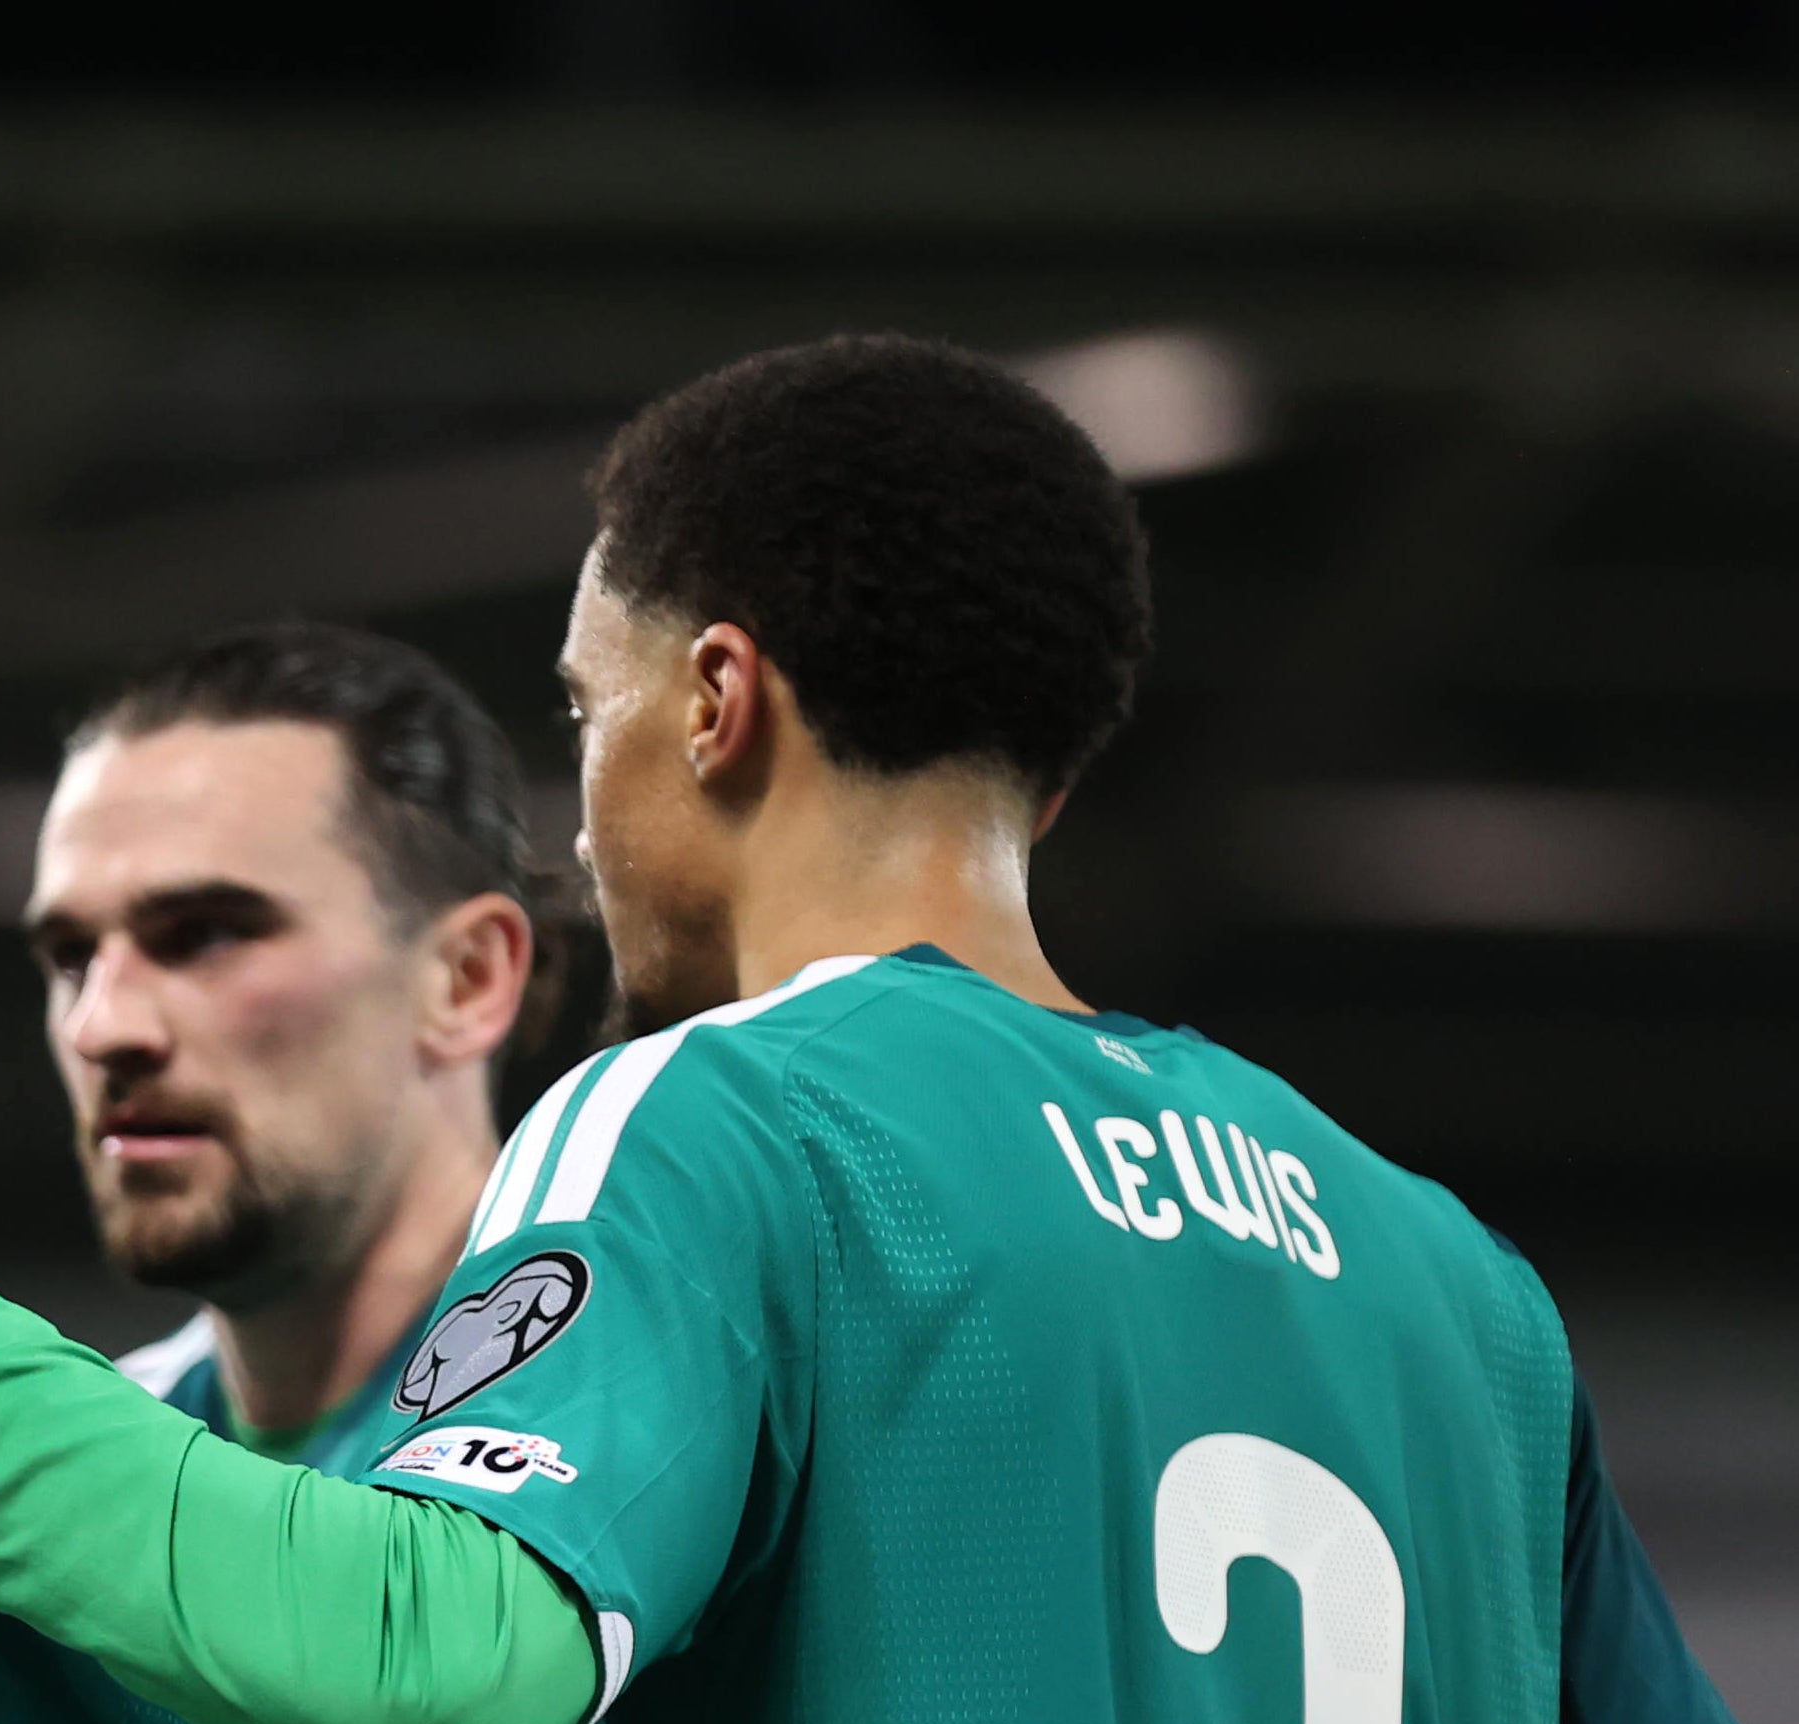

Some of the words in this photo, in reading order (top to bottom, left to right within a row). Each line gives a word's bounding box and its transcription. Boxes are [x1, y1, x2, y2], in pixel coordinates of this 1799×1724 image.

[1042, 1101, 1341, 1280] LEWIS
[459, 1438, 529, 1474] 10
[533, 1458, 569, 1477] YEARS
